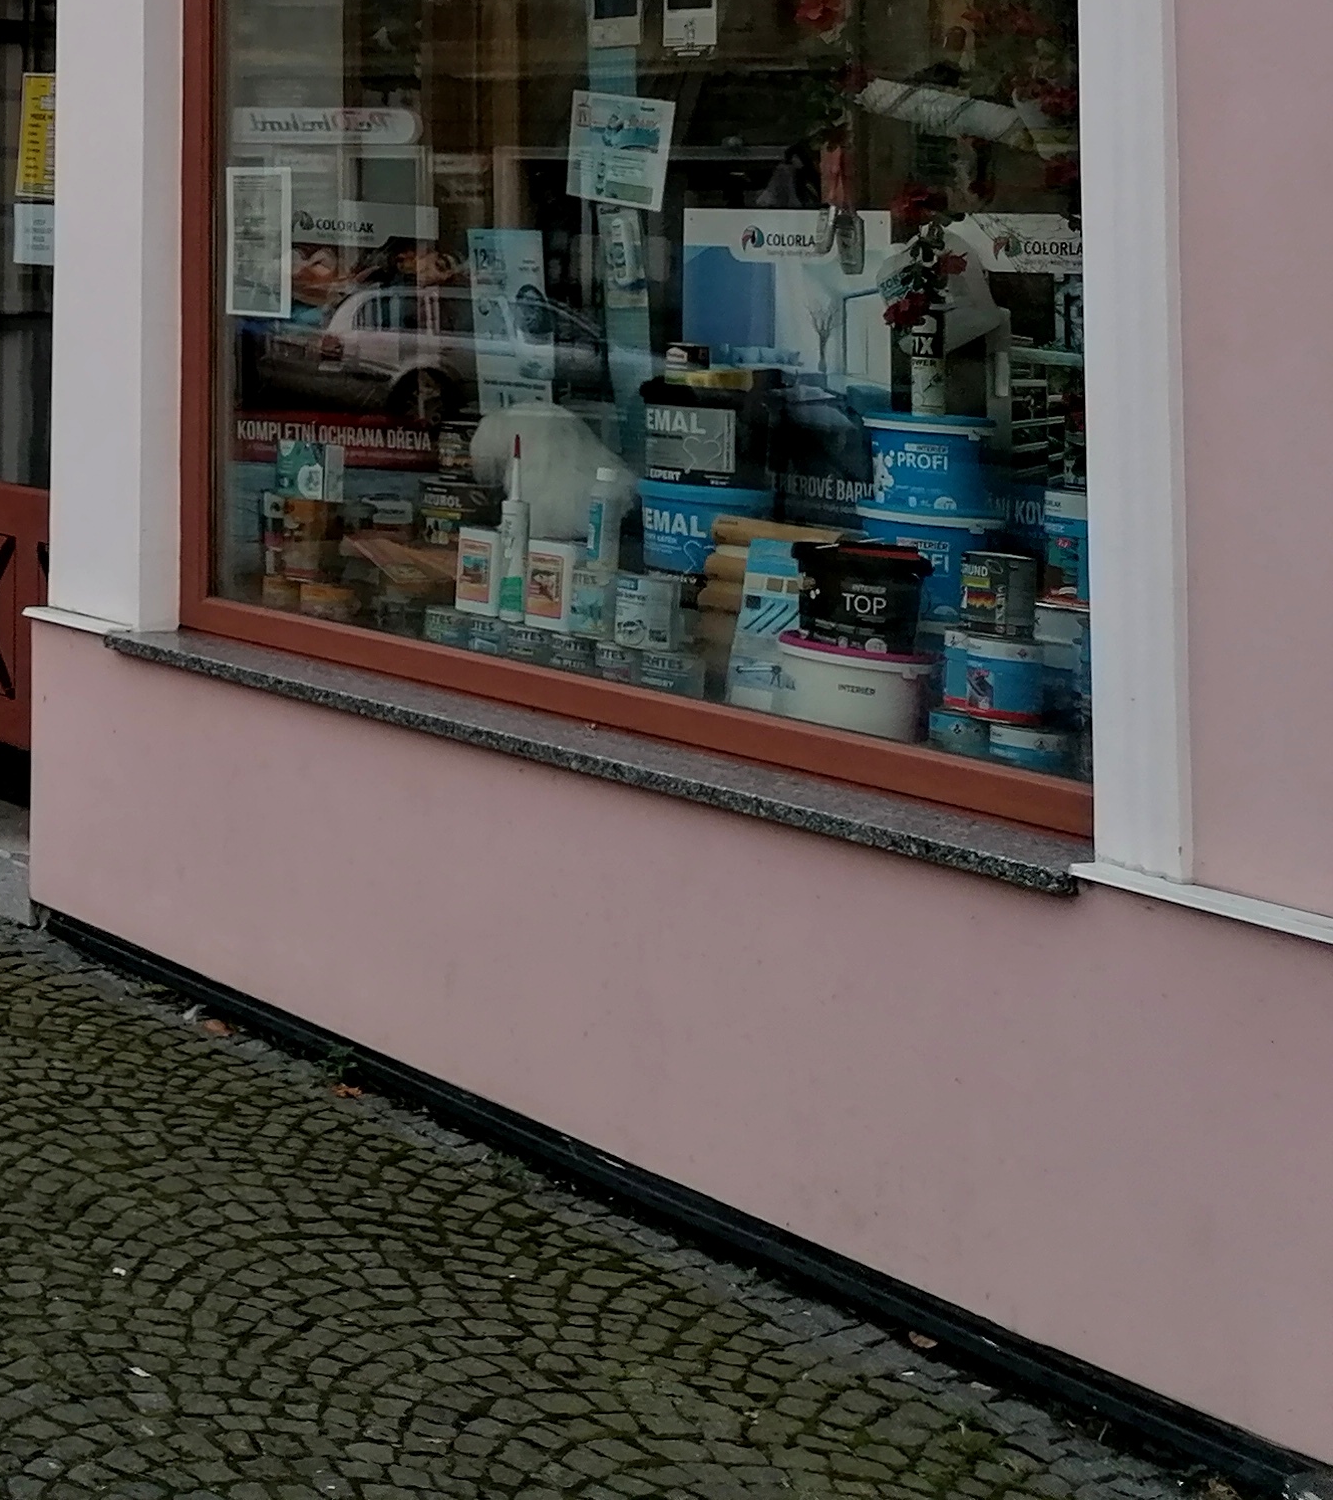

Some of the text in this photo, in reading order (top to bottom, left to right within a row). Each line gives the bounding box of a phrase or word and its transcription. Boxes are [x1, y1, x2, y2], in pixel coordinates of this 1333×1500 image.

[315, 218, 375, 234] COLORLAK
[236, 420, 433, 451] KOMPLETNÍ OCHRANA DŘEVA
[896, 450, 949, 472] PROFI
[644, 507, 708, 539] EMAL
[841, 592, 888, 616] TOP
